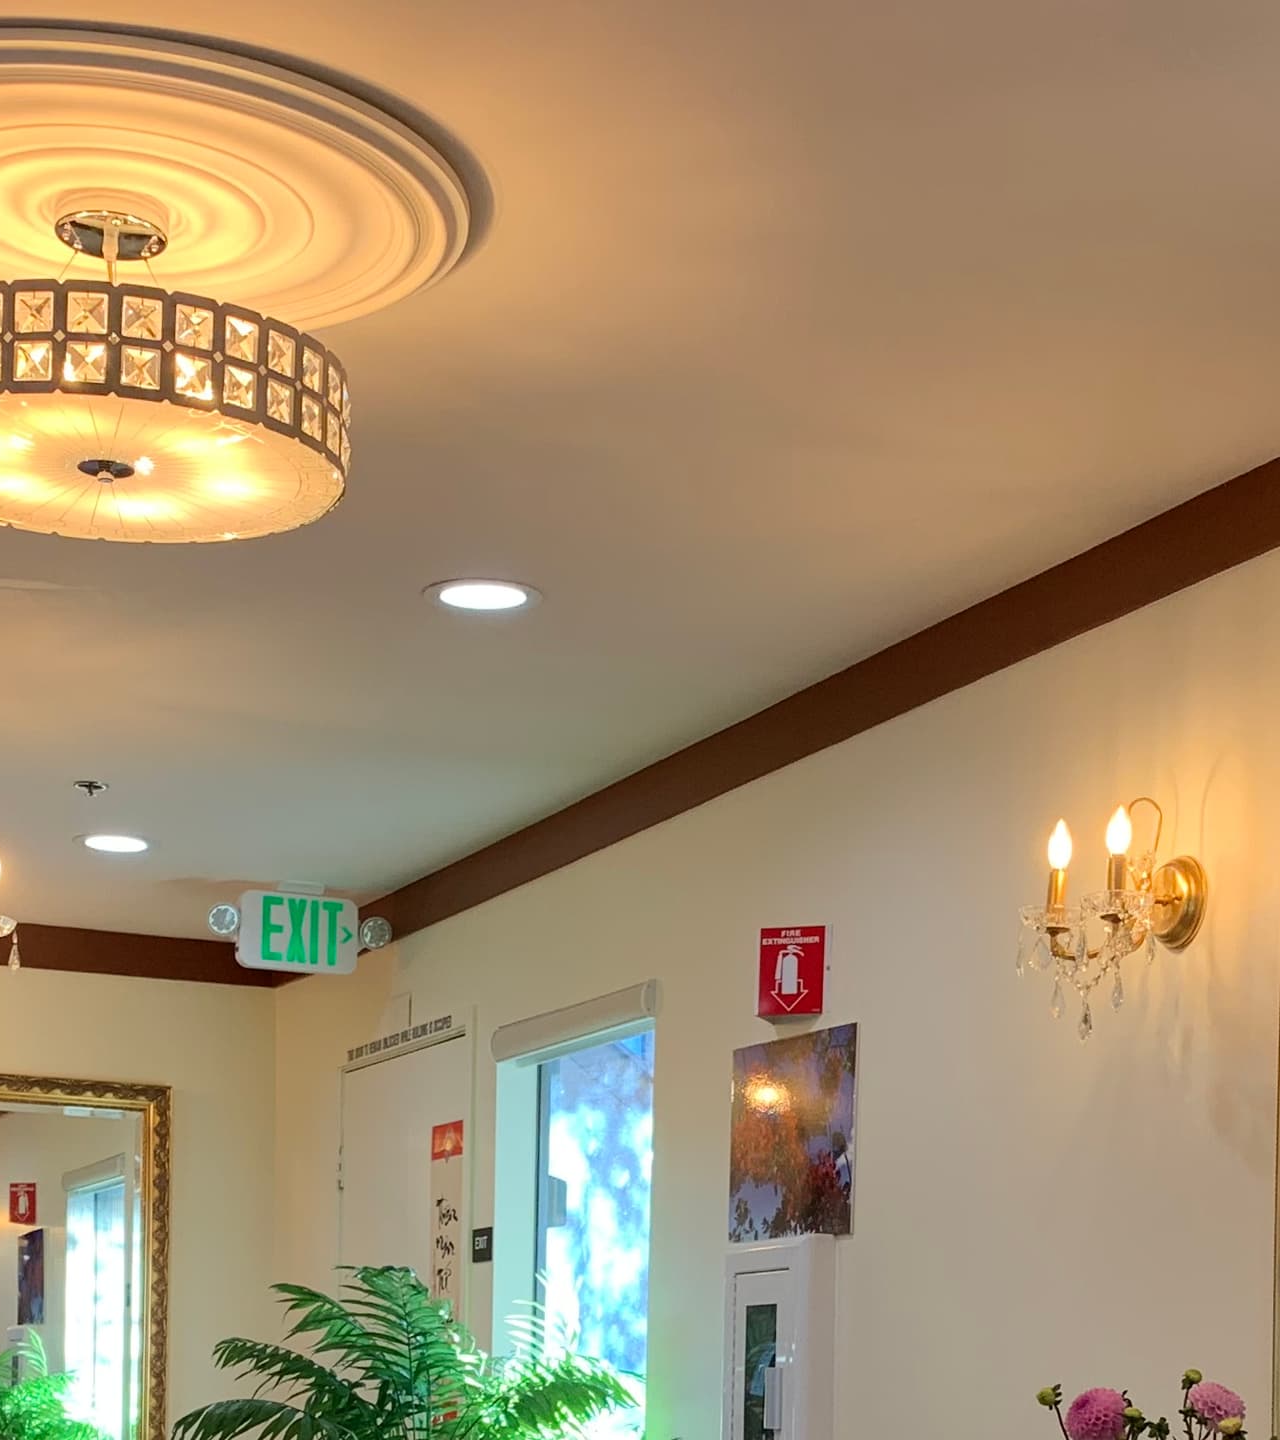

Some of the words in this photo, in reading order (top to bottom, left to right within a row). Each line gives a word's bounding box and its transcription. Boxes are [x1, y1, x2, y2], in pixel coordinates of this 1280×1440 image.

[261, 895, 343, 967] EXIT
[781, 929, 801, 938] FIRE
[762, 936, 820, 945] EXTINGUISHER
[475, 1236, 488, 1250] EXIT
